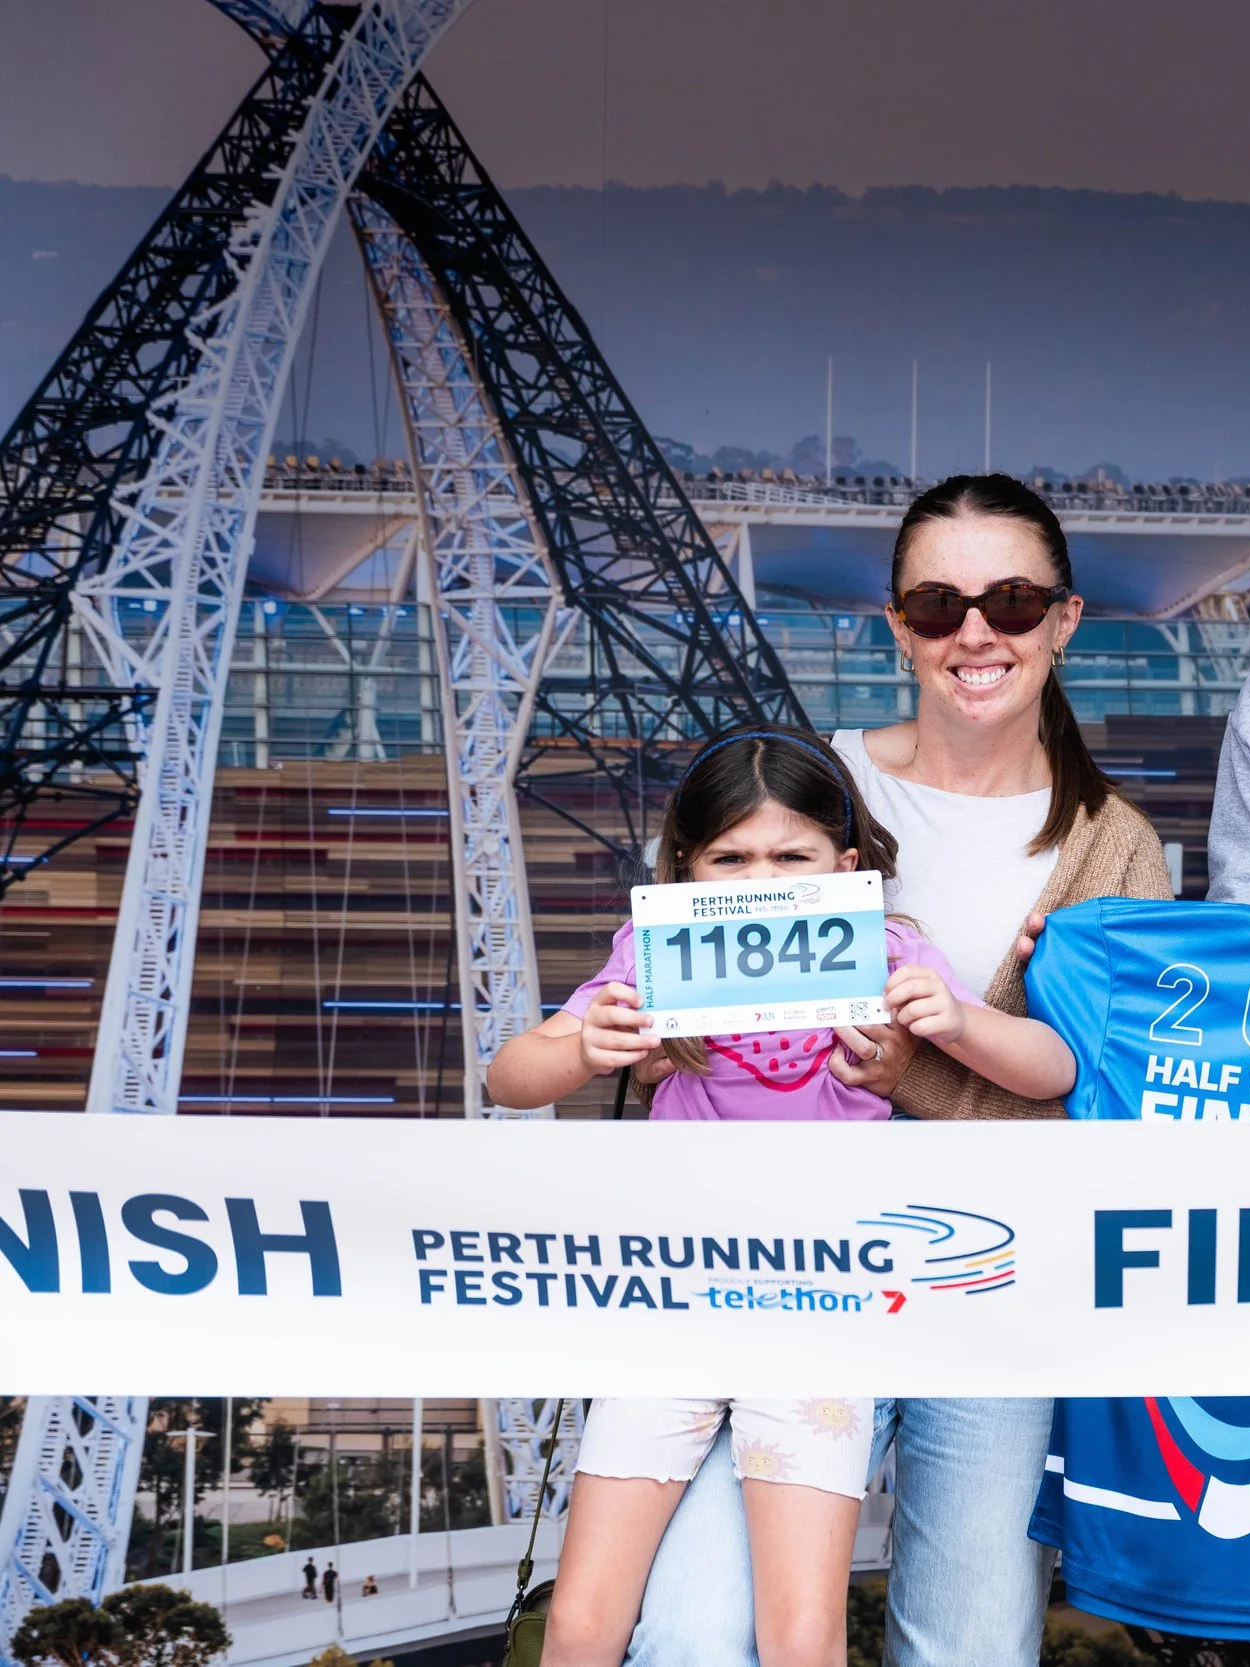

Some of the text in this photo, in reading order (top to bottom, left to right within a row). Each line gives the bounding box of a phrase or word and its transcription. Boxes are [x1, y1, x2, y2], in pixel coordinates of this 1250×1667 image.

[692, 891, 796, 907] PERTH RUNNING
[693, 905, 752, 918] FESTIVAL
[643, 929, 654, 1008] HALF MARATHON
[666, 917, 857, 981] 11842
[1146, 1054, 1242, 1093] HALF
[411, 1230, 894, 1274] PERTH RUNNING
[418, 1268, 690, 1310] FESTIVAL
[706, 1286, 864, 1313] telethon
